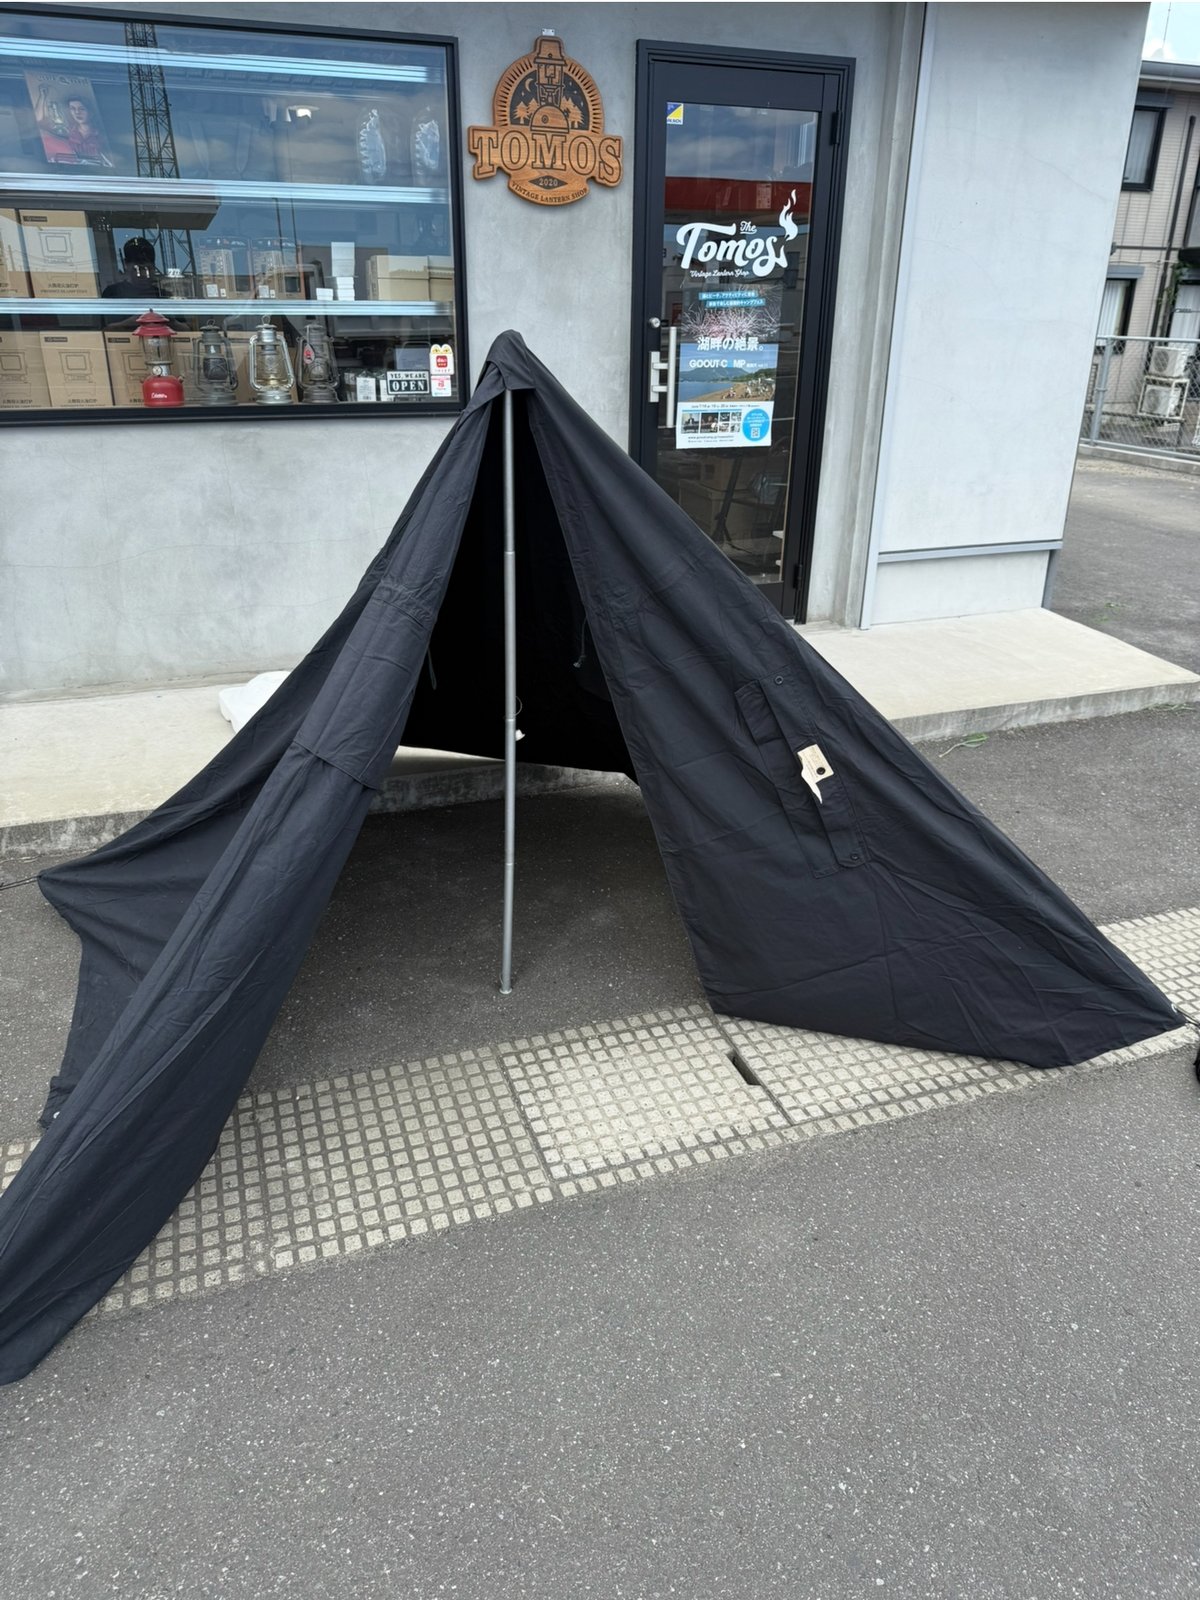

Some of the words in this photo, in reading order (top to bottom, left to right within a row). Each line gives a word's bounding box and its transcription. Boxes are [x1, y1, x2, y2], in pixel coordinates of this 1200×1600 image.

[472, 130, 622, 184] TOMOS
[539, 178, 558, 186] 2020
[512, 181, 539, 201] VINTAGE
[541, 195, 571, 203] LANTERN
[572, 187, 588, 199] SHOP
[740, 220, 757, 235] The
[676, 222, 788, 277] Tomos
[690, 270, 711, 279] Vintage
[734, 268, 749, 278] Shop
[697, 336, 764, 351] 湖畔の絶景。
[392, 380, 424, 391] OPEN
